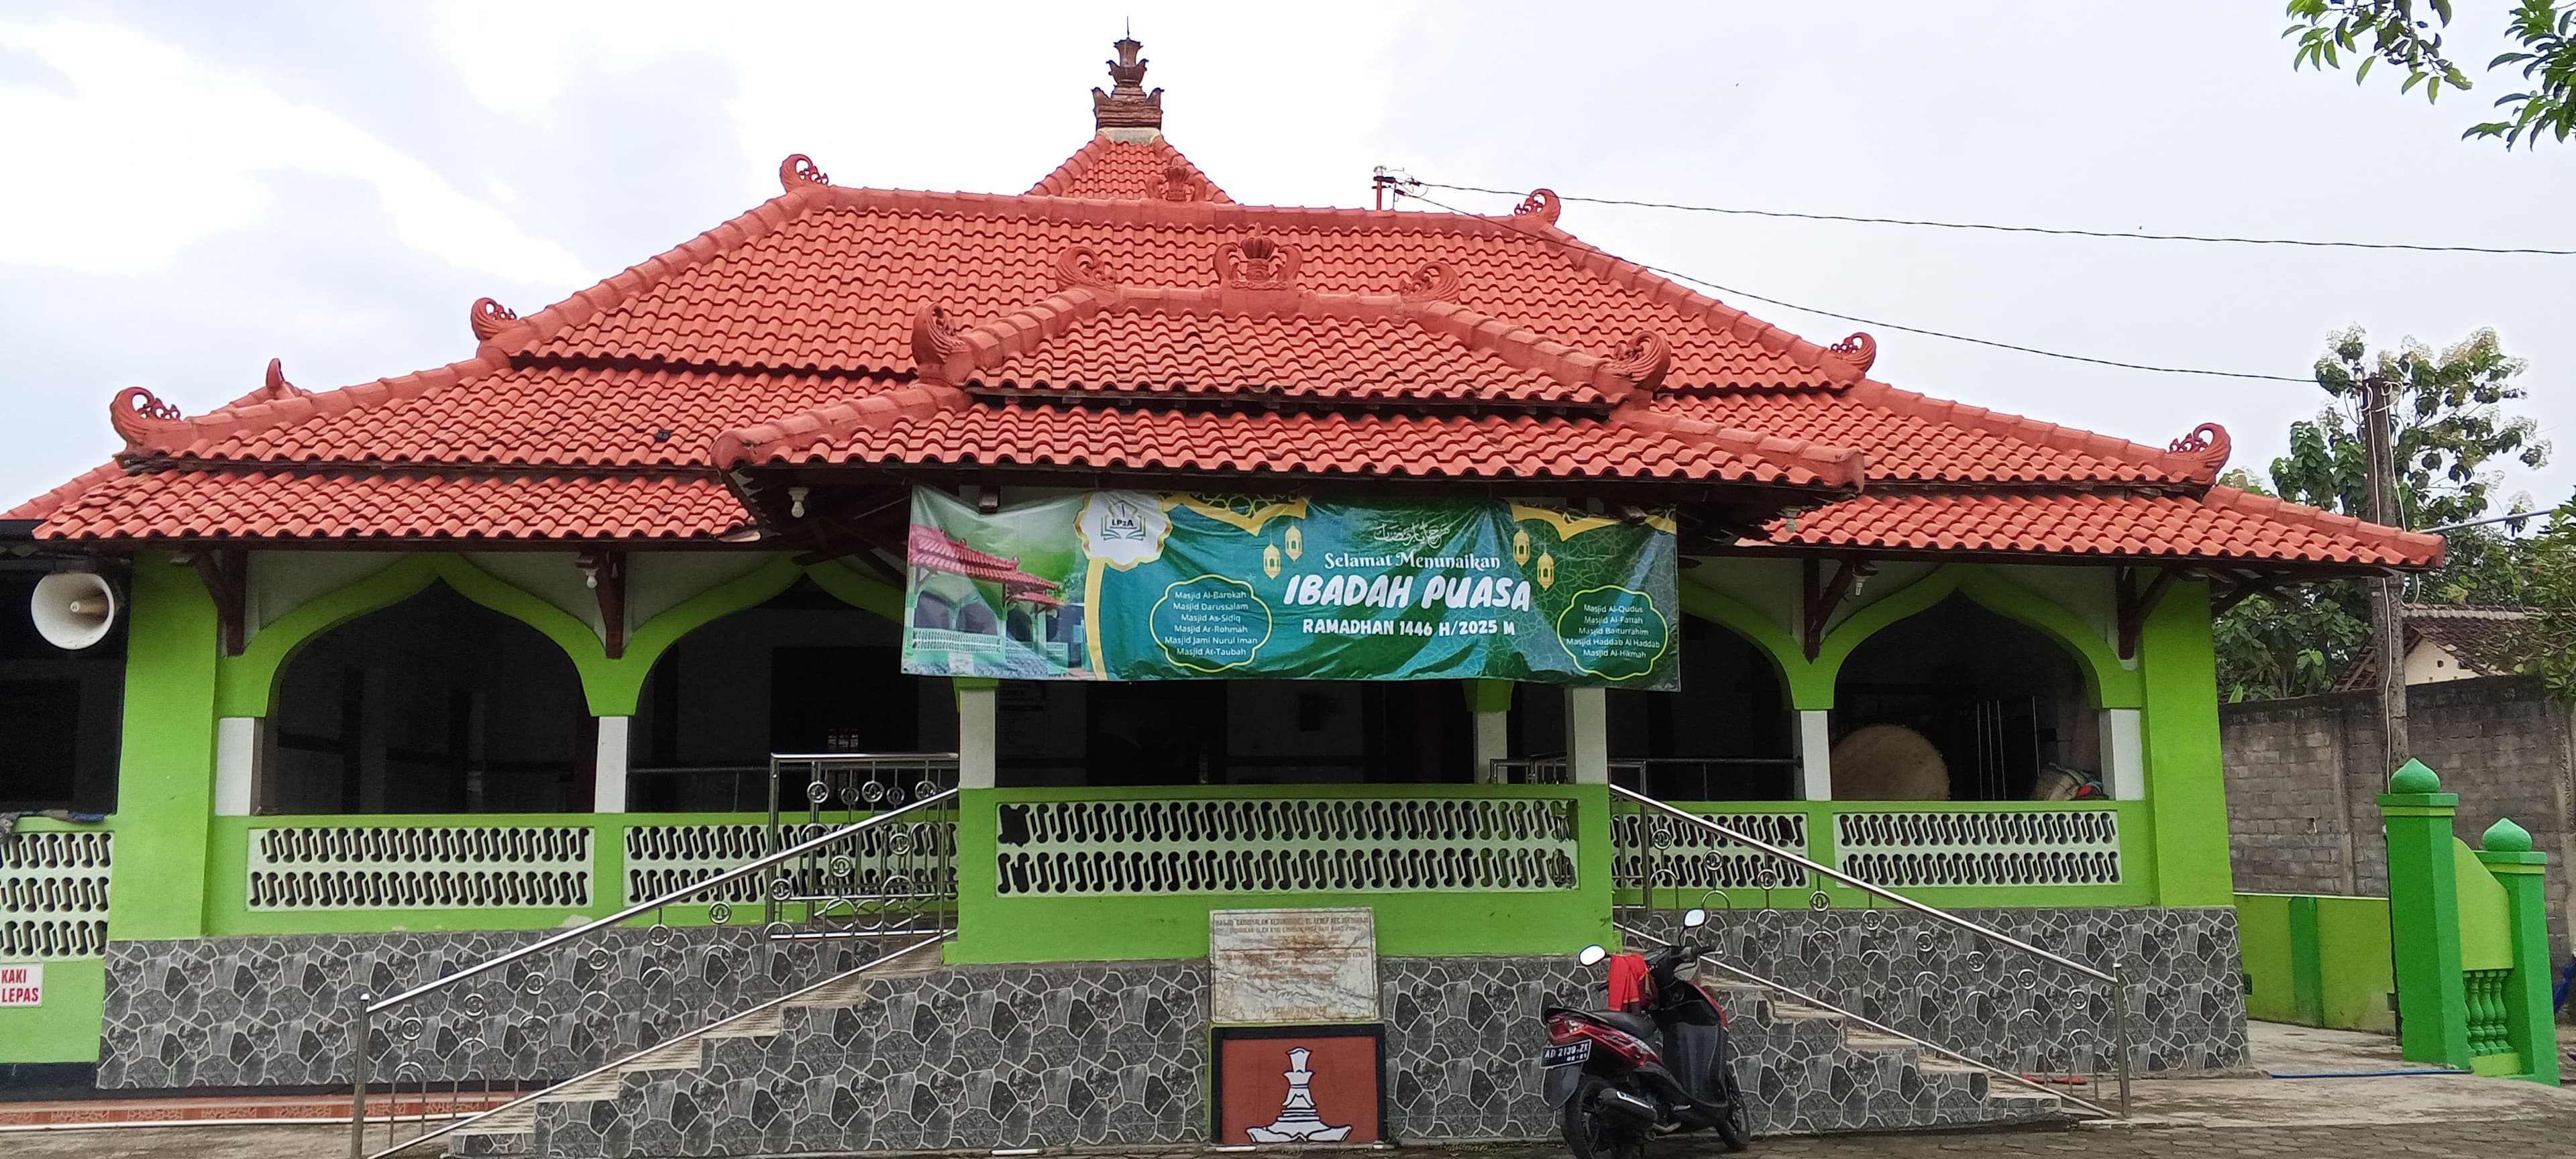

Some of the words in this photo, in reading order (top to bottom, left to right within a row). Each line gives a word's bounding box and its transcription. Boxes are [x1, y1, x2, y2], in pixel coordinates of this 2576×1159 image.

[1111, 518, 1134, 527] LP2A
[1324, 552, 1393, 569] Selamat
[1395, 551, 1501, 571] Menunaikan
[1175, 592, 1201, 601] Masjid
[1203, 591, 1246, 599] Al-Barokah
[1283, 574, 1413, 607] IBADAH
[1421, 575, 1531, 612] PUASA
[1173, 602, 1199, 612] Masjid
[1584, 604, 1607, 614] Masjid
[1609, 605, 1643, 613] Al-Qudus
[1181, 614, 1207, 622] Masjid
[1209, 614, 1241, 623] As-Sidiq
[1584, 616, 1608, 625] Masjid
[1610, 616, 1643, 624] Al-Fattah
[1174, 625, 1201, 634] Masjid
[1202, 625, 1248, 633] Ar-Rohmah
[1303, 618, 1394, 635] RAMADHAN
[1399, 620, 1433, 637] 1446
[1439, 619, 1497, 637] H/2025
[1503, 621, 1515, 636] M
[1578, 627, 1603, 637] Masjid
[1165, 637, 1191, 645] Masjid
[1193, 637, 1210, 645] Jami
[1566, 638, 1591, 647] Masjid
[1633, 640, 1660, 649] Haddab
[1177, 648, 1203, 657] Masjid
[1204, 648, 1246, 656] At-Taubah
[1583, 649, 1609, 658] Masjid
[1610, 649, 1646, 659] Al-Hikmah
[2, 969, 27, 984] KAKI
[2, 987, 39, 1003] LEPAS
[1544, 1049, 1556, 1058] AD
